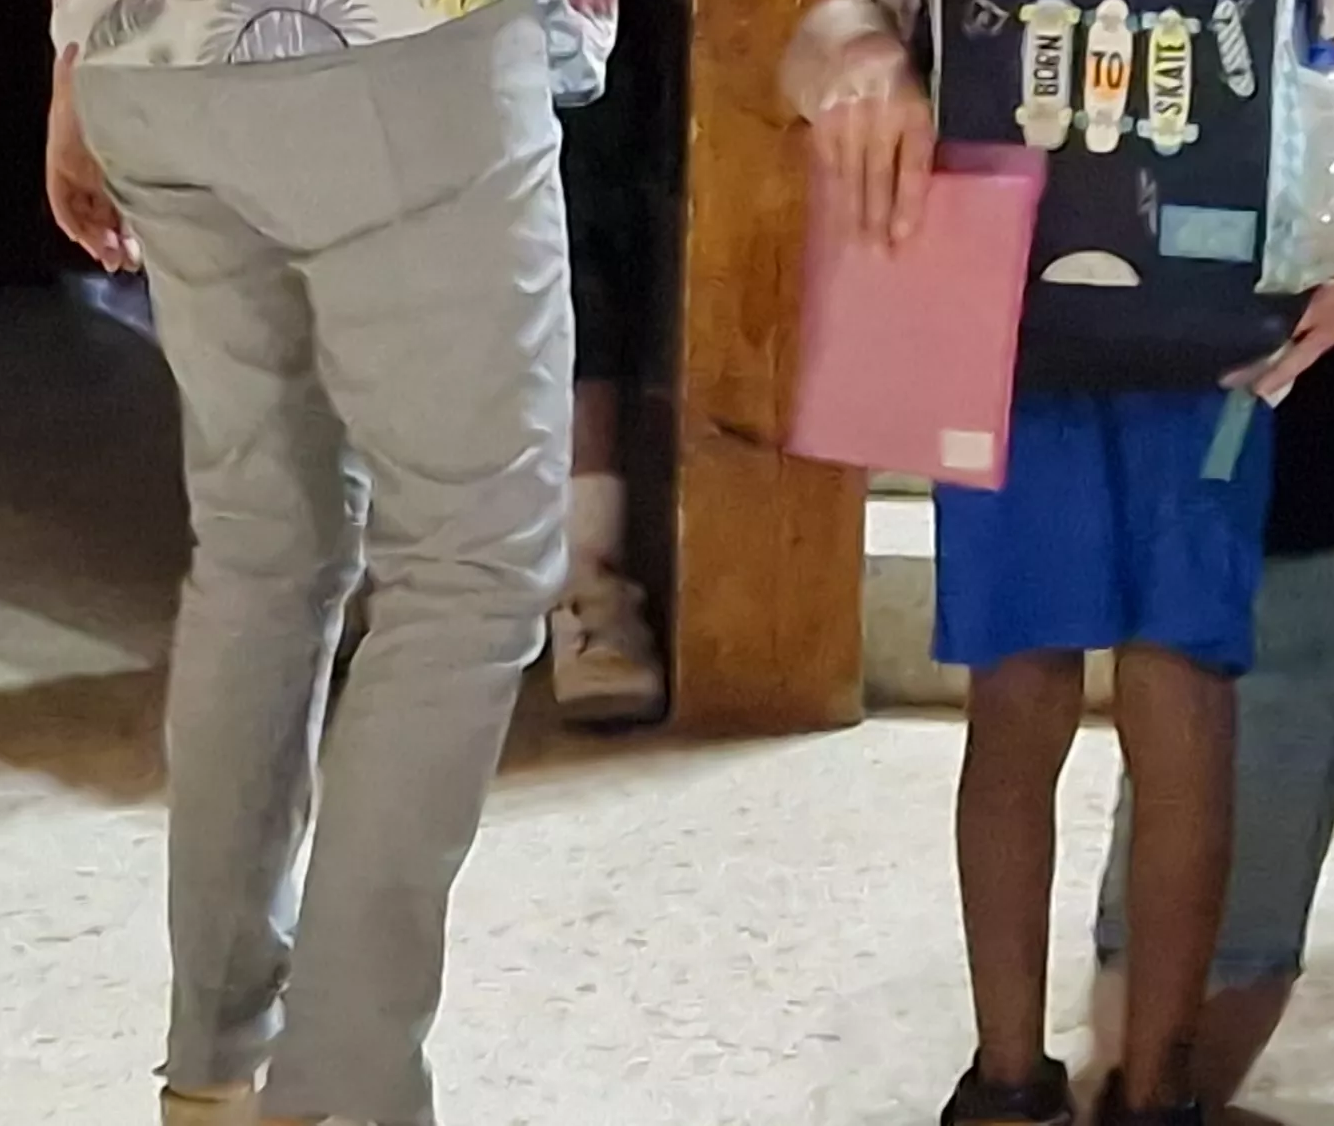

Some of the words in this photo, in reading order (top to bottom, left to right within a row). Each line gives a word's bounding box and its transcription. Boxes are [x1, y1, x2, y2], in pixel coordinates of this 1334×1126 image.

[1033, 34, 1062, 97] BORN
[1090, 51, 1123, 91] TO
[1154, 40, 1185, 116] SKATE
